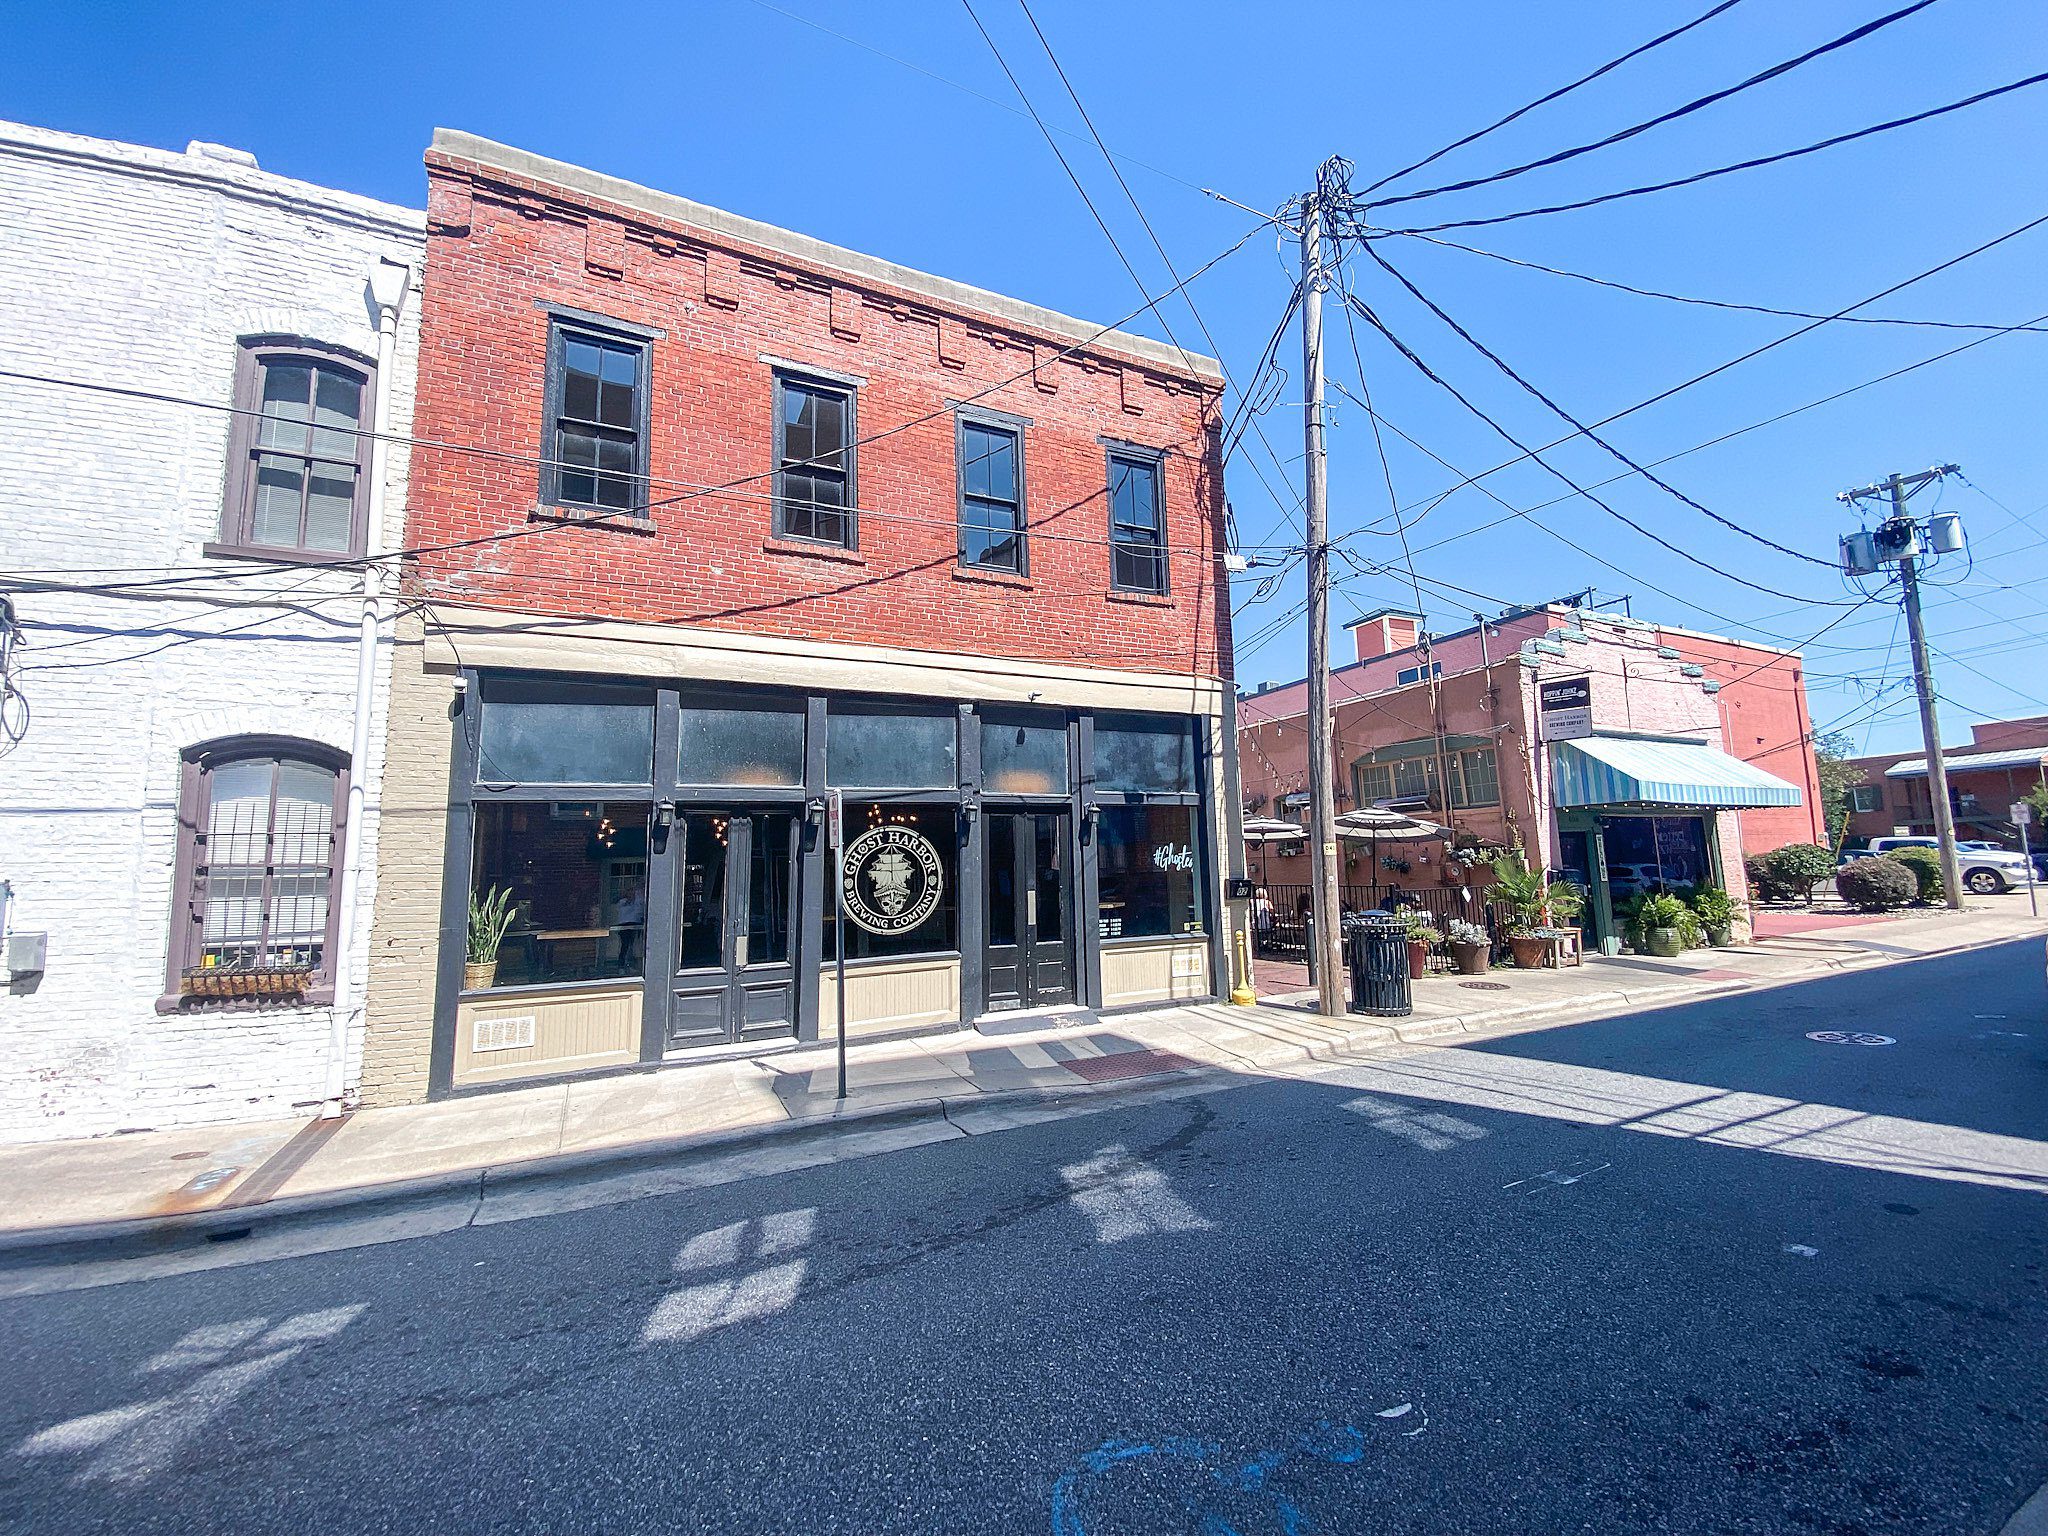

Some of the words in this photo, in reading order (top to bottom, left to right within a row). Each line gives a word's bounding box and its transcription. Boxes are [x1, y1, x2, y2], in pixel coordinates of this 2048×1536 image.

[844, 833, 884, 875] GHOST
[888, 832, 936, 874] HARBOR
[846, 890, 889, 928] BREWING
[893, 886, 938, 928] COMPANY
